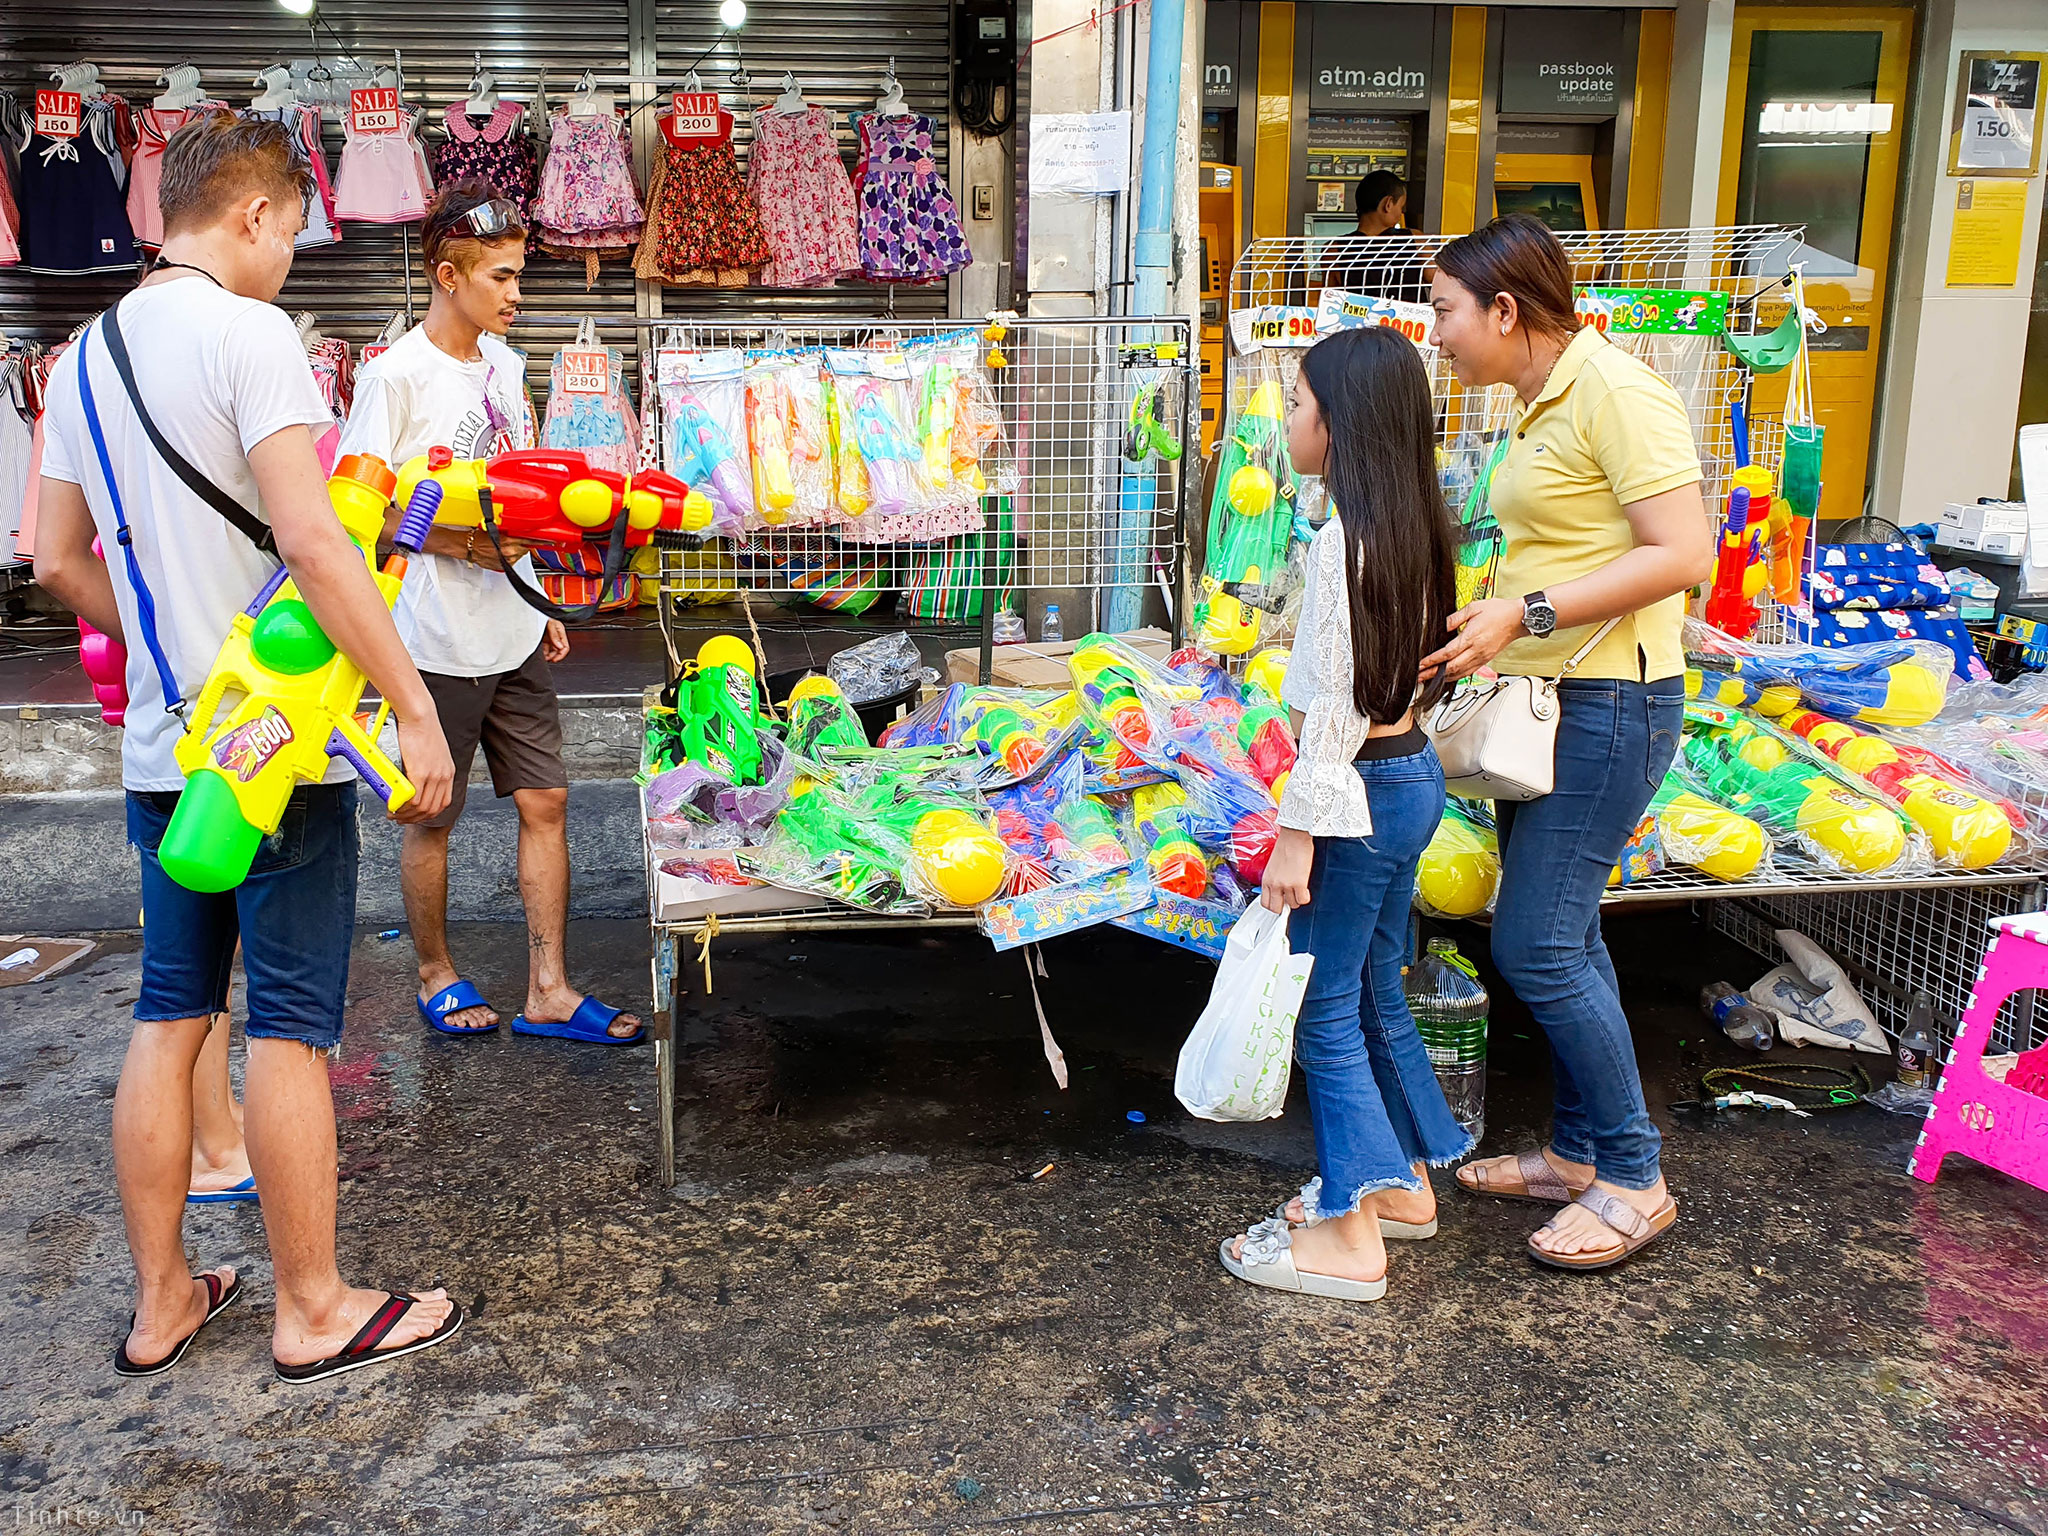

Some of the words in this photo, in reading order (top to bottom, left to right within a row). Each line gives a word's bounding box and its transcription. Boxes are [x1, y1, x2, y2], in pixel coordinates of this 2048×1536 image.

[1540, 61, 1614, 77] passbook
[1560, 77, 1614, 93] update
[37, 93, 78, 115] SALE
[353, 90, 396, 112] SALE
[675, 96, 717, 115] SALE
[44, 119, 69, 131] 150
[360, 115, 387, 127] 150
[682, 118, 711, 129] 200
[1342, 301, 1369, 317] Power
[1251, 321, 1285, 342] Power
[1289, 317, 1318, 337] 90
[565, 355, 606, 374] SALE
[569, 376, 599, 388] 290
[245, 713, 292, 763] 1500
